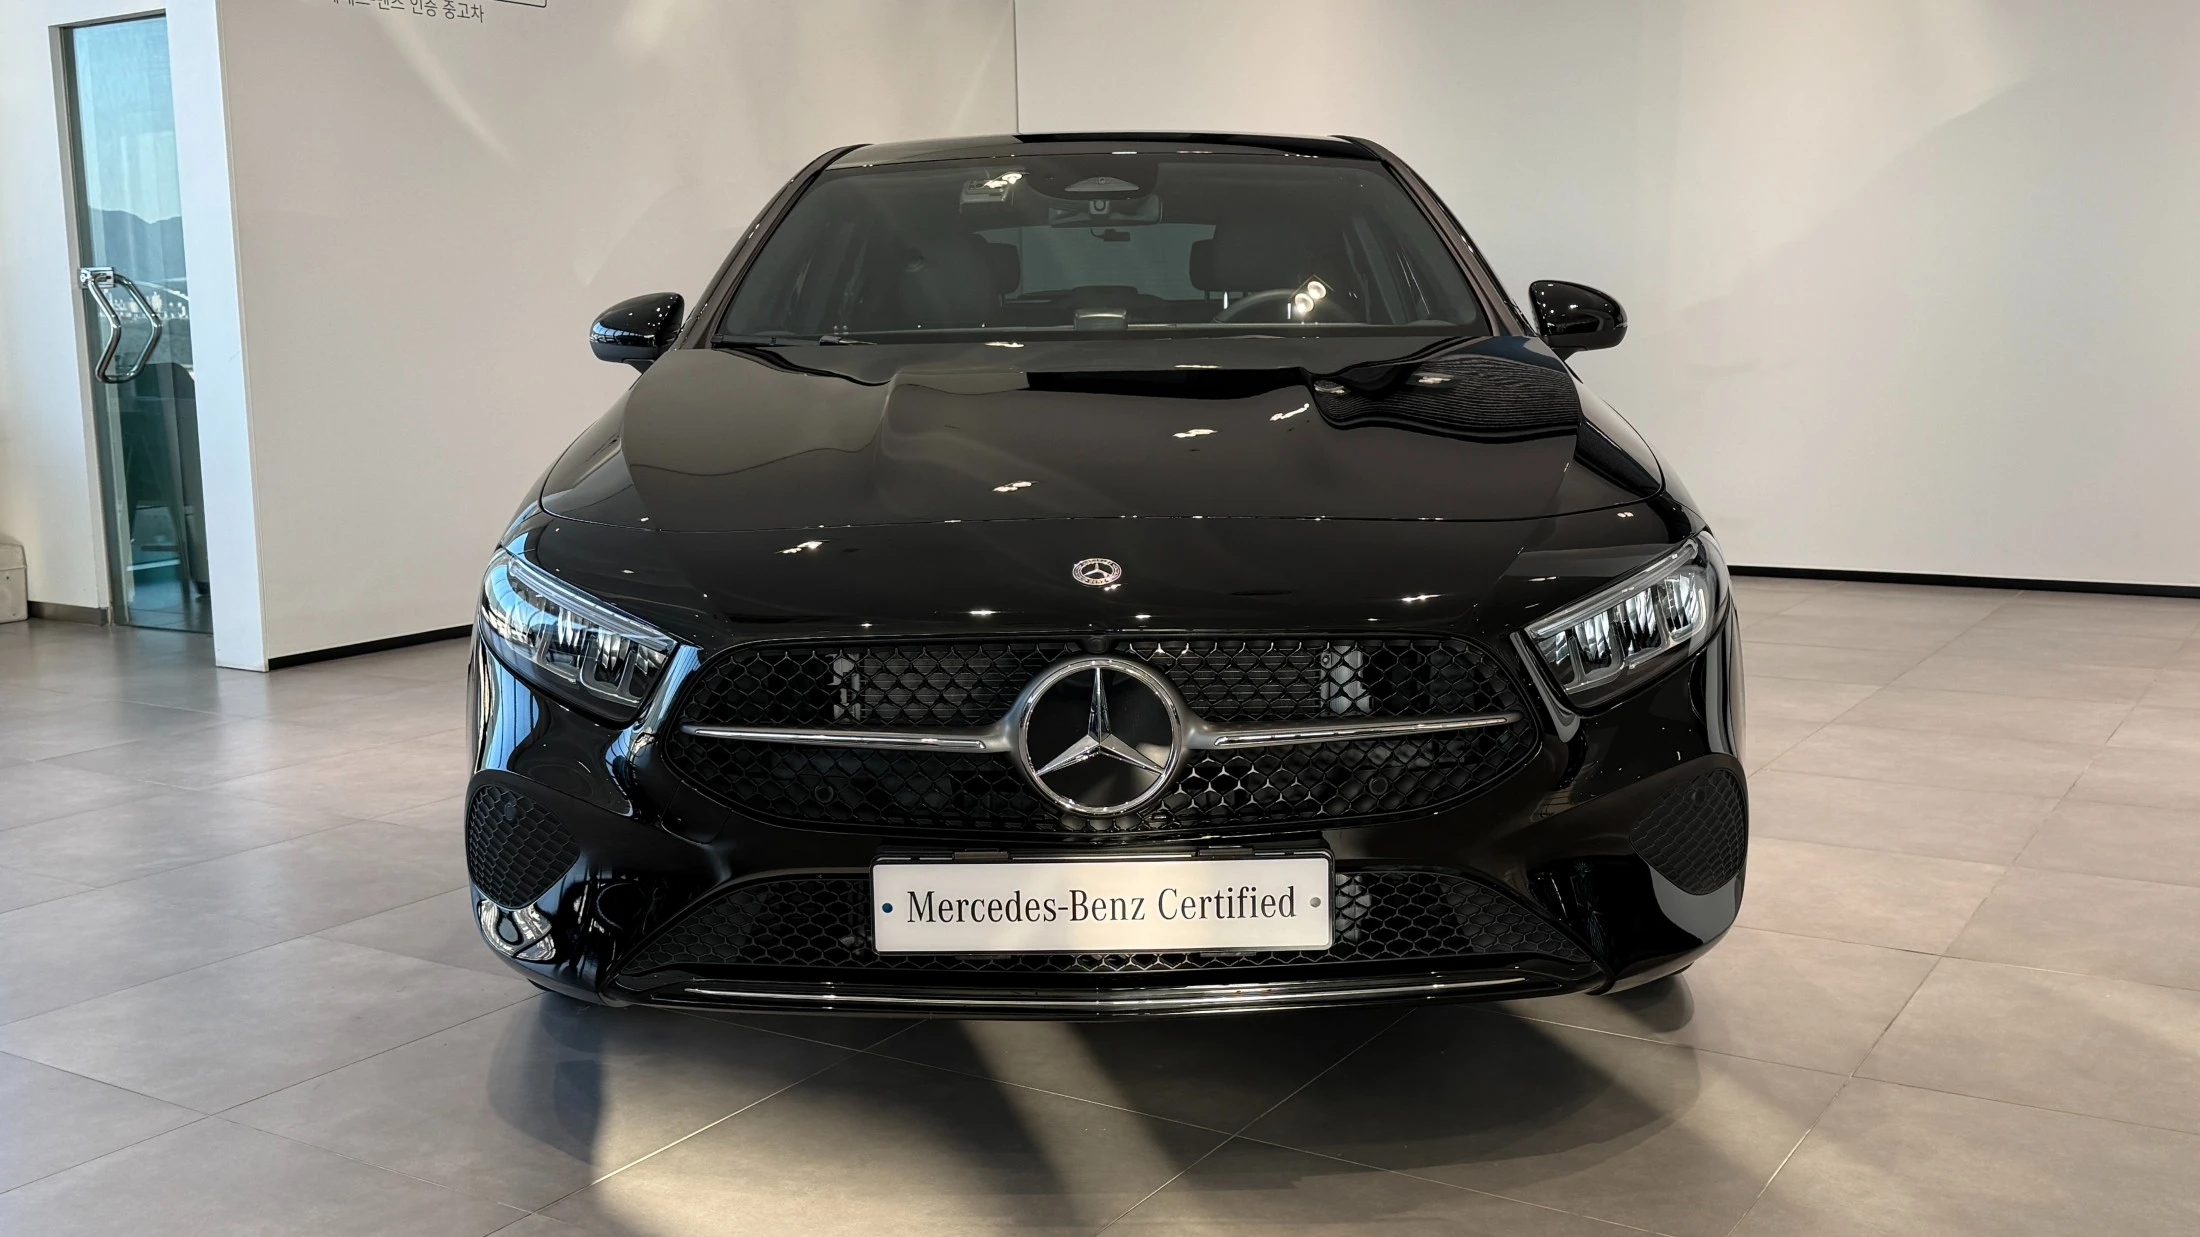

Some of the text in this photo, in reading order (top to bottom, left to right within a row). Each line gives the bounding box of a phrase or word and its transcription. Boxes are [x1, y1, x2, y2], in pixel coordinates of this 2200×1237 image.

[443, 0, 484, 23] 중고차
[907, 885, 1297, 923] Mercedes-Benz Certified
